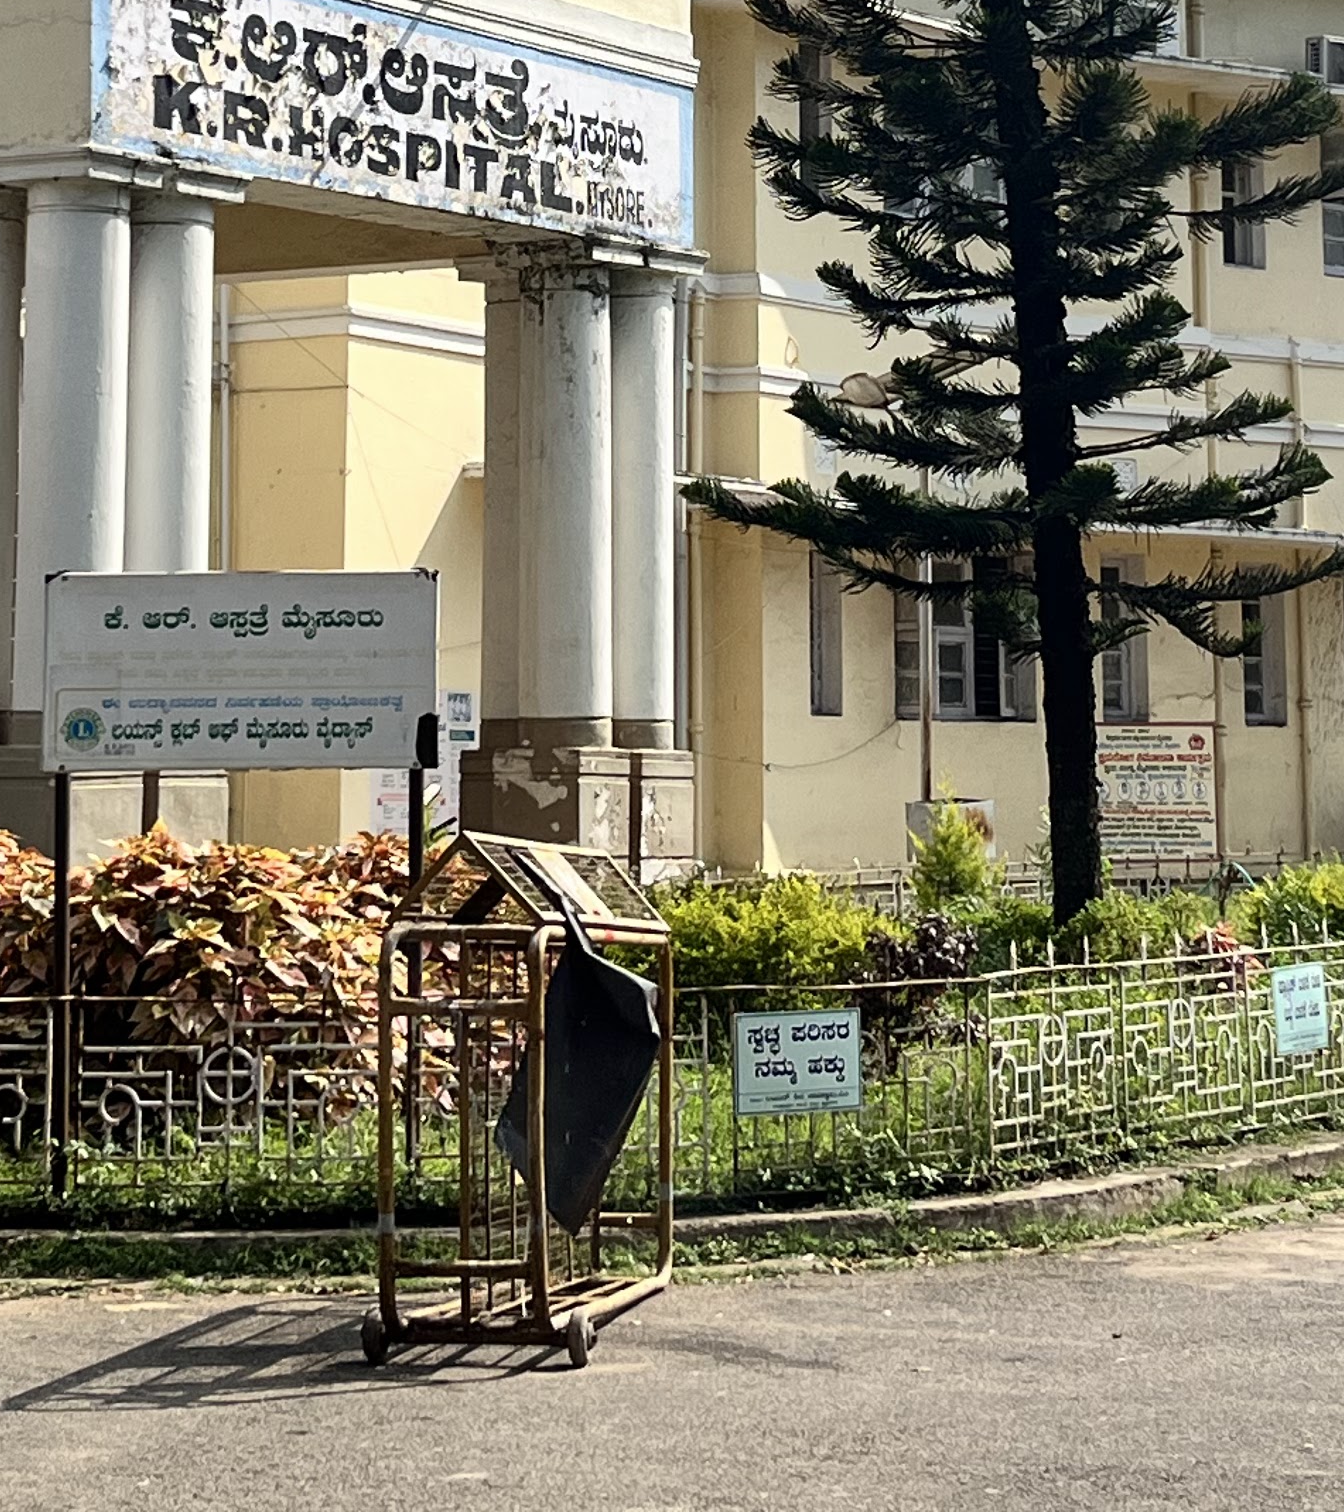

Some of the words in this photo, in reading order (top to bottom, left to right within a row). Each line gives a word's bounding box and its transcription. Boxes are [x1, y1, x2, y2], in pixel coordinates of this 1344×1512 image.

[103, 604, 129, 630] ಕೆ.
[208, 604, 270, 637] ಆಸ್ಪತ್ರೆ
[281, 603, 385, 640] ಮೈಸೂರು
[246, 716, 310, 749] ಮೈಸೂರು
[791, 1020, 851, 1042] ಪರಿಸರ
[754, 1057, 798, 1085] ನಮ್ಮ
[807, 1054, 847, 1082] ಹಕ್ಕು
